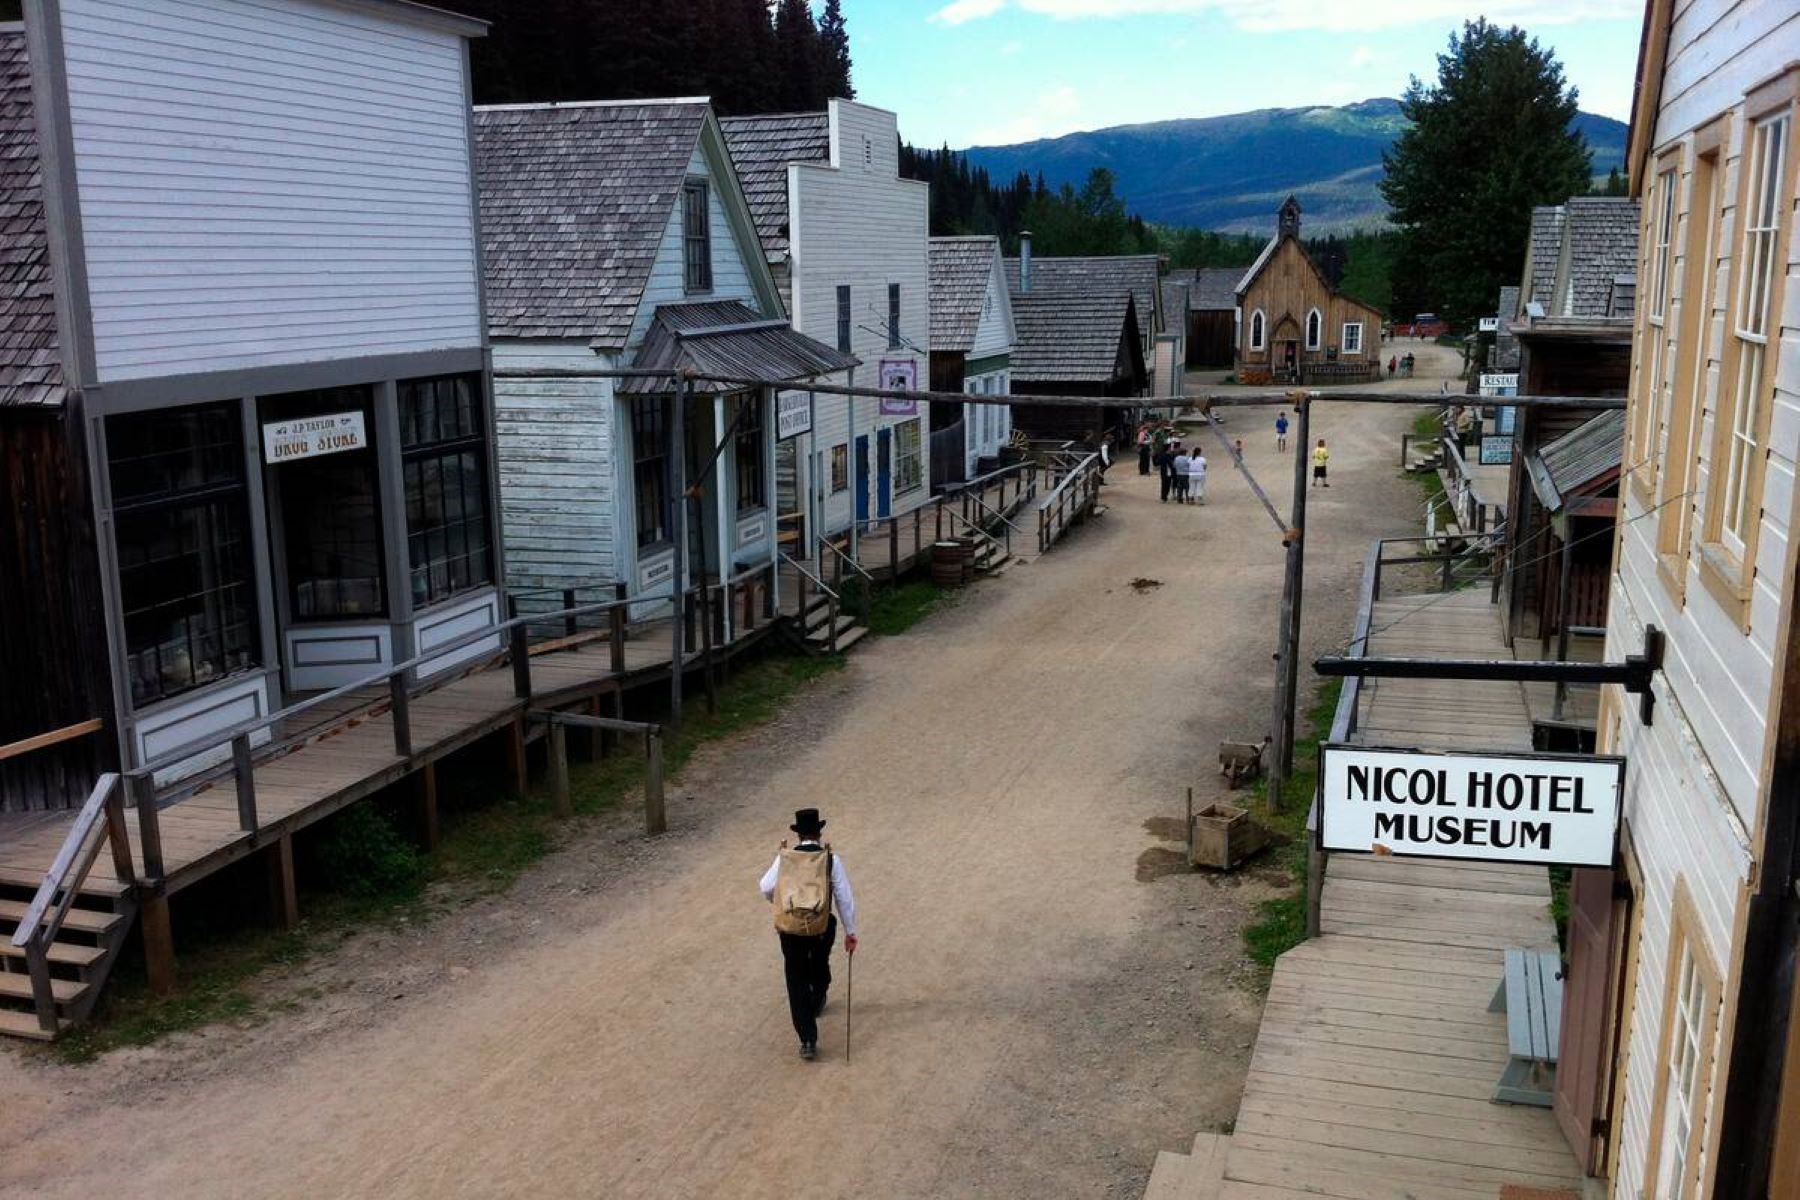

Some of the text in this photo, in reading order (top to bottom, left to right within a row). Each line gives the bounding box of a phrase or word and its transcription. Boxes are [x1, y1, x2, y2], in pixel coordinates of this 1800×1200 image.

[306, 419, 335, 432] TAYLOR
[274, 433, 358, 457] DRUG STORE
[1346, 765, 1594, 814] NICOL HOTEL
[1374, 812, 1551, 850] MUSEUM
